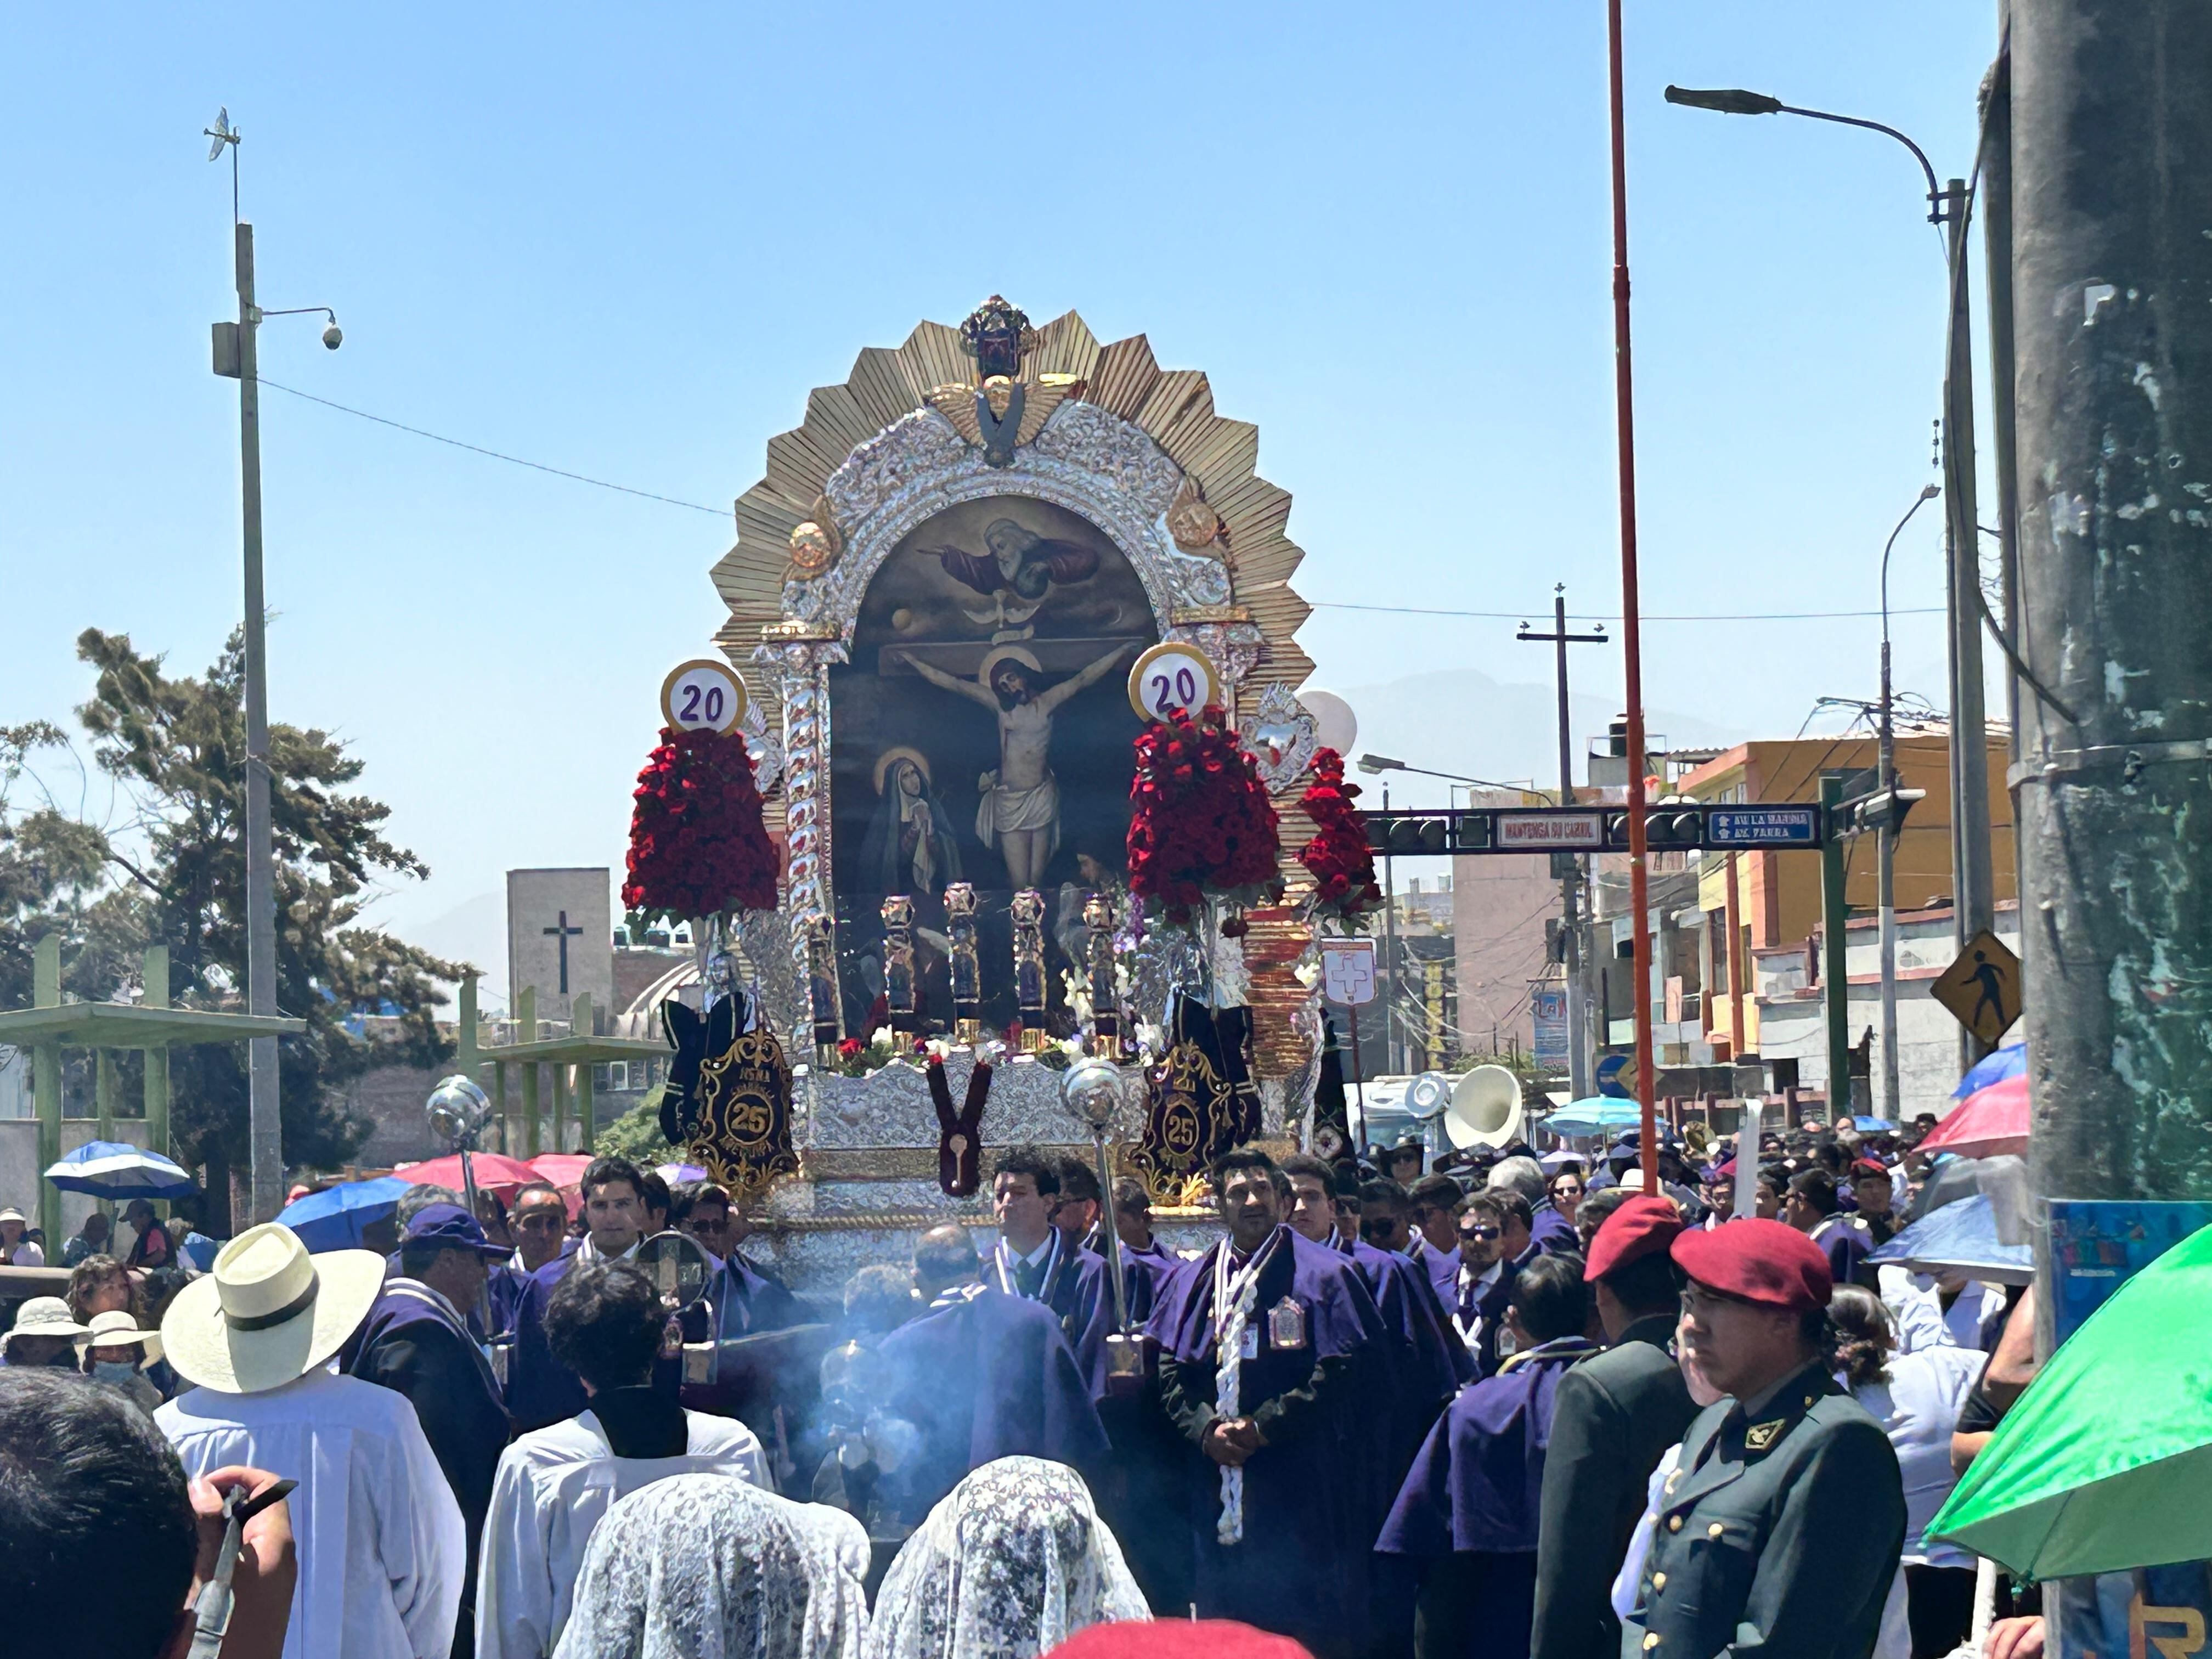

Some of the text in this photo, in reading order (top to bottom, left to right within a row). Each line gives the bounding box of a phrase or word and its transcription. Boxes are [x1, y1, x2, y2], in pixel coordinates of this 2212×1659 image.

[680, 685, 724, 721] 20
[1152, 668, 1195, 713] 20
[1424, 963, 1445, 1070] HOSTAL
[731, 1102, 769, 1133] 25
[1168, 1115, 1194, 1146] 25
